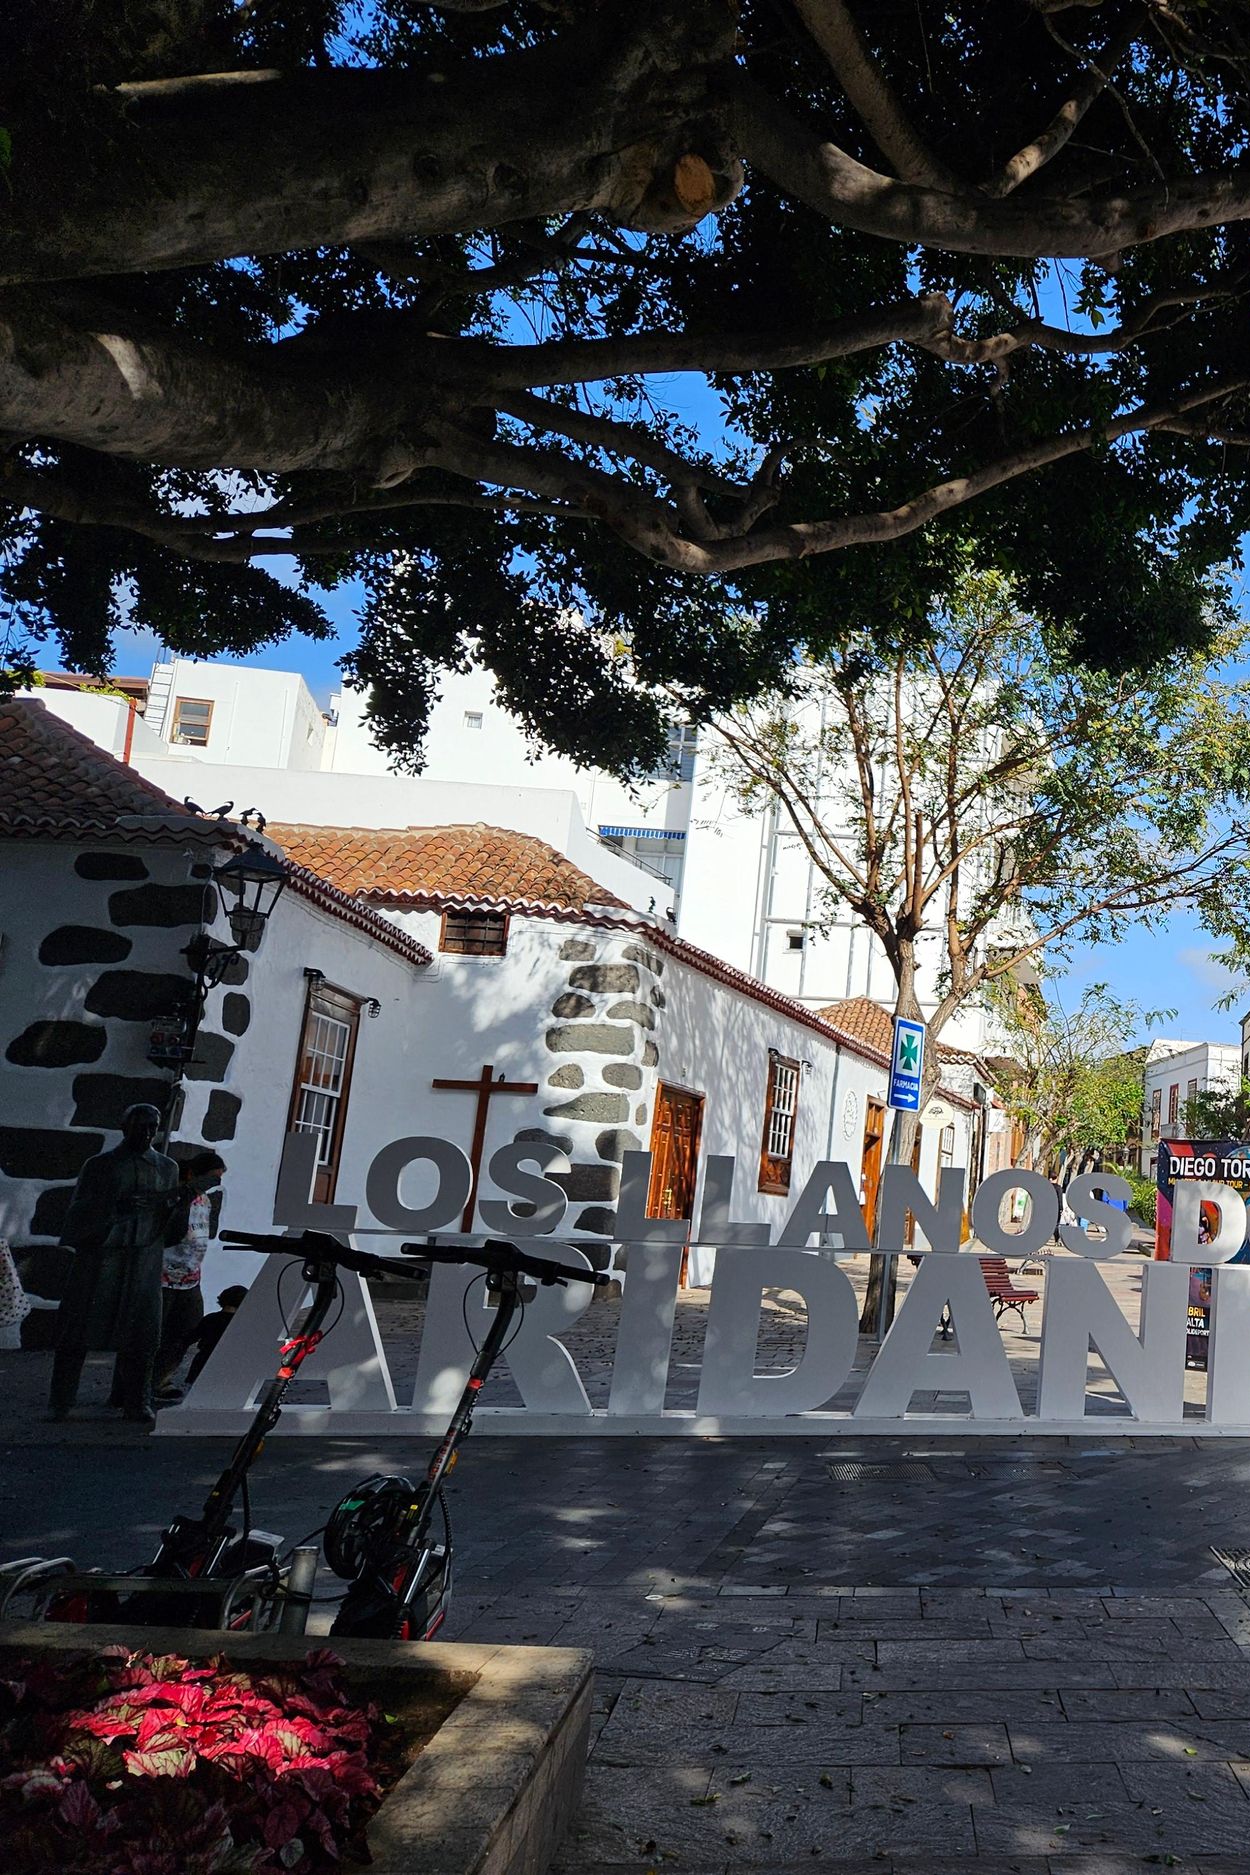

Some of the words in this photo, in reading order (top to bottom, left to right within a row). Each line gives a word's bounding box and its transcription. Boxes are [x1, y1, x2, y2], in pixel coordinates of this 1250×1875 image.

[893, 1078, 919, 1092] FARMACIA
[1169, 1156, 1216, 1177] DIEGO
[273, 1131, 572, 1237] LOS
[613, 1151, 1136, 1260] LLANOS
[1187, 1306, 1206, 1317] BRIL
